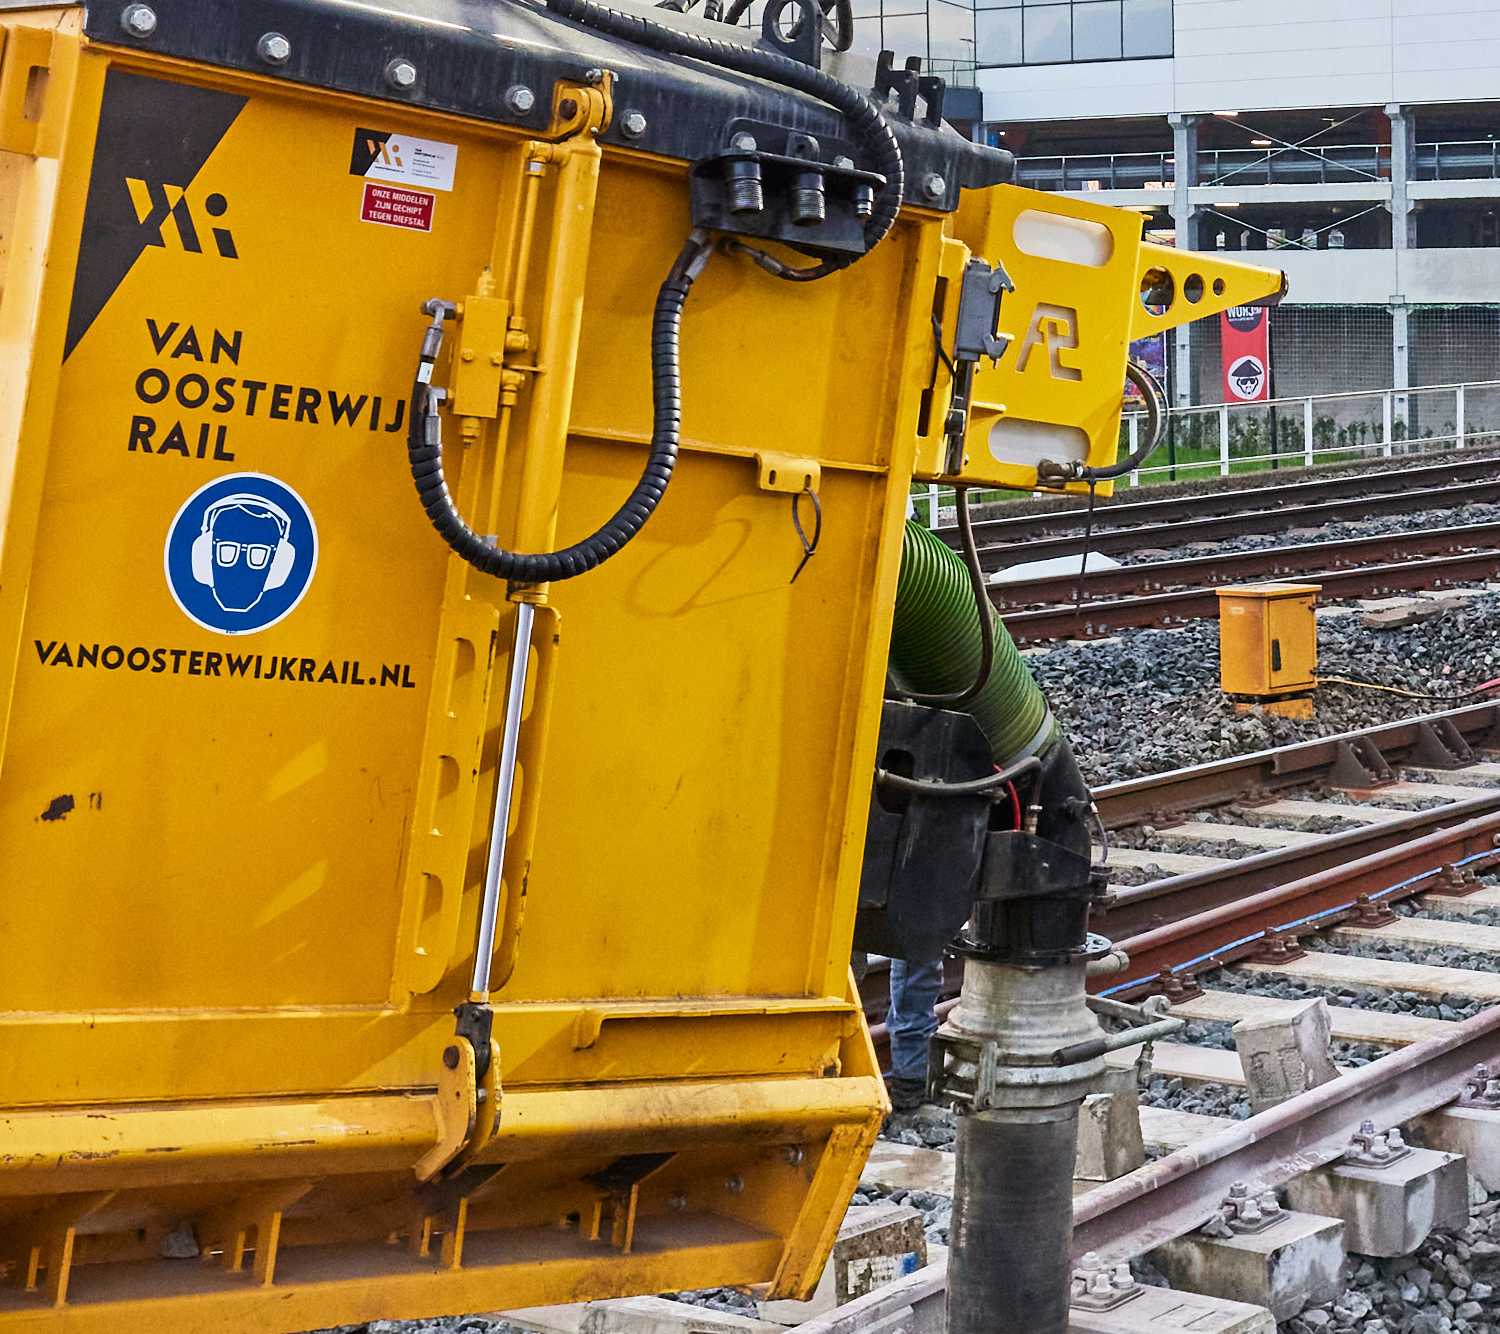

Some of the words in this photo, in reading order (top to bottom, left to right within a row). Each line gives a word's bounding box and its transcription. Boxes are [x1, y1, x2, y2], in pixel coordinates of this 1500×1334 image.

[368, 211, 391, 221] TEGEN
[392, 214, 425, 227] DIEFSTAL
[372, 188, 391, 199] ONZE
[392, 192, 429, 206] MIDDELEN
[374, 200, 391, 210] ZIJN
[392, 204, 423, 215] GECHIPT
[145, 318, 243, 365] VAN
[134, 367, 408, 434] OOSTERWIJ
[127, 413, 236, 462] RAIL
[34, 639, 416, 690] VANOOSTERWIJKRAIL.NL
